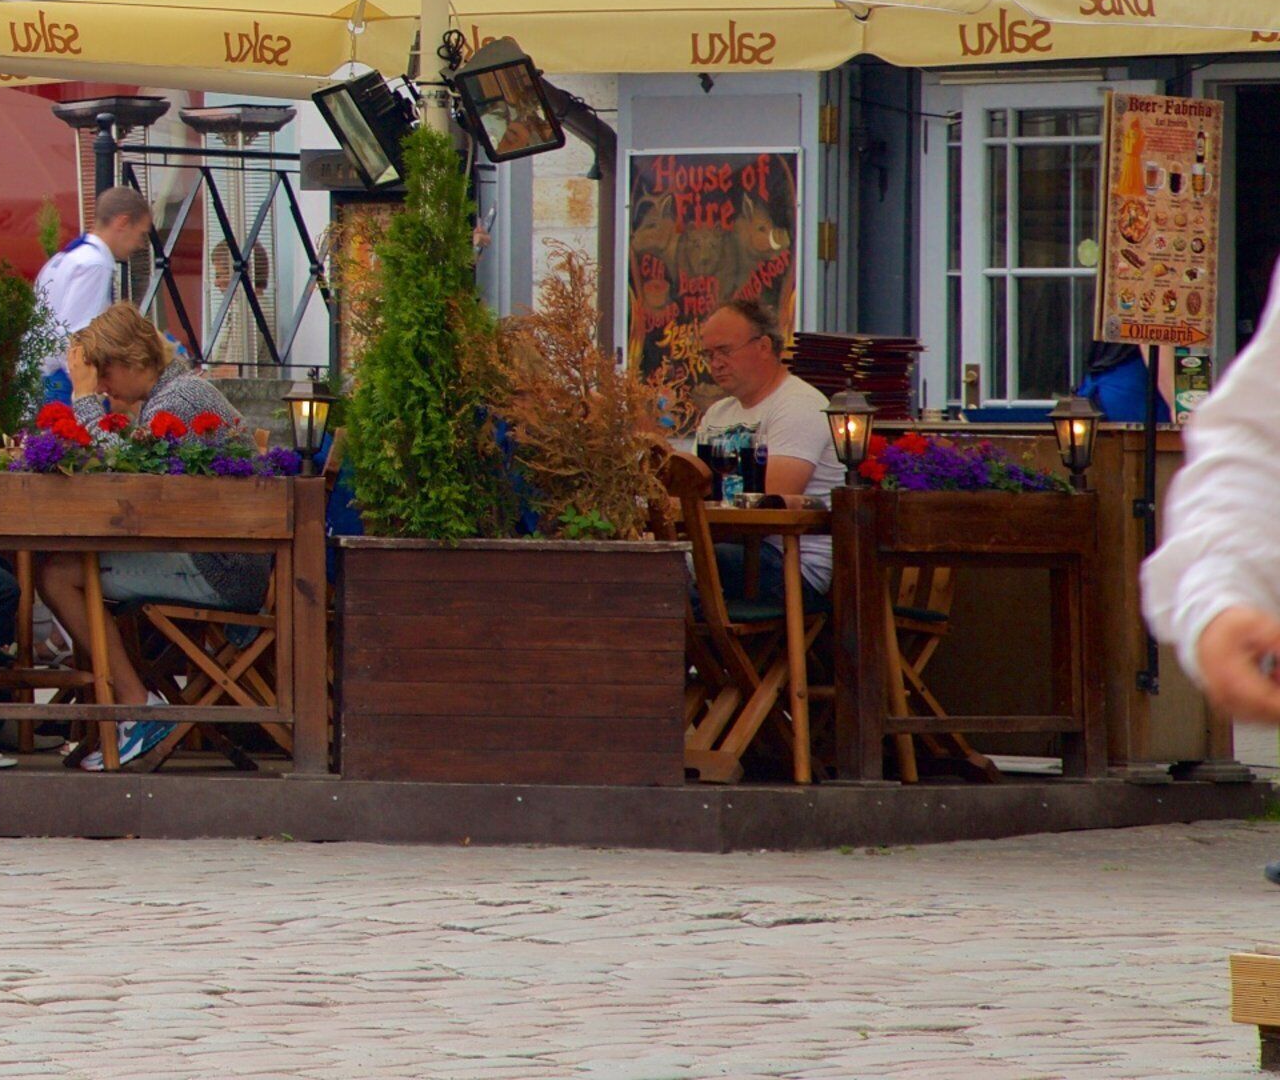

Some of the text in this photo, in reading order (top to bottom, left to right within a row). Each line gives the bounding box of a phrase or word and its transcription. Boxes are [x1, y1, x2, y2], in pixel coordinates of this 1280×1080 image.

[651, 153, 771, 201] House of
[674, 192, 736, 233] Fire
